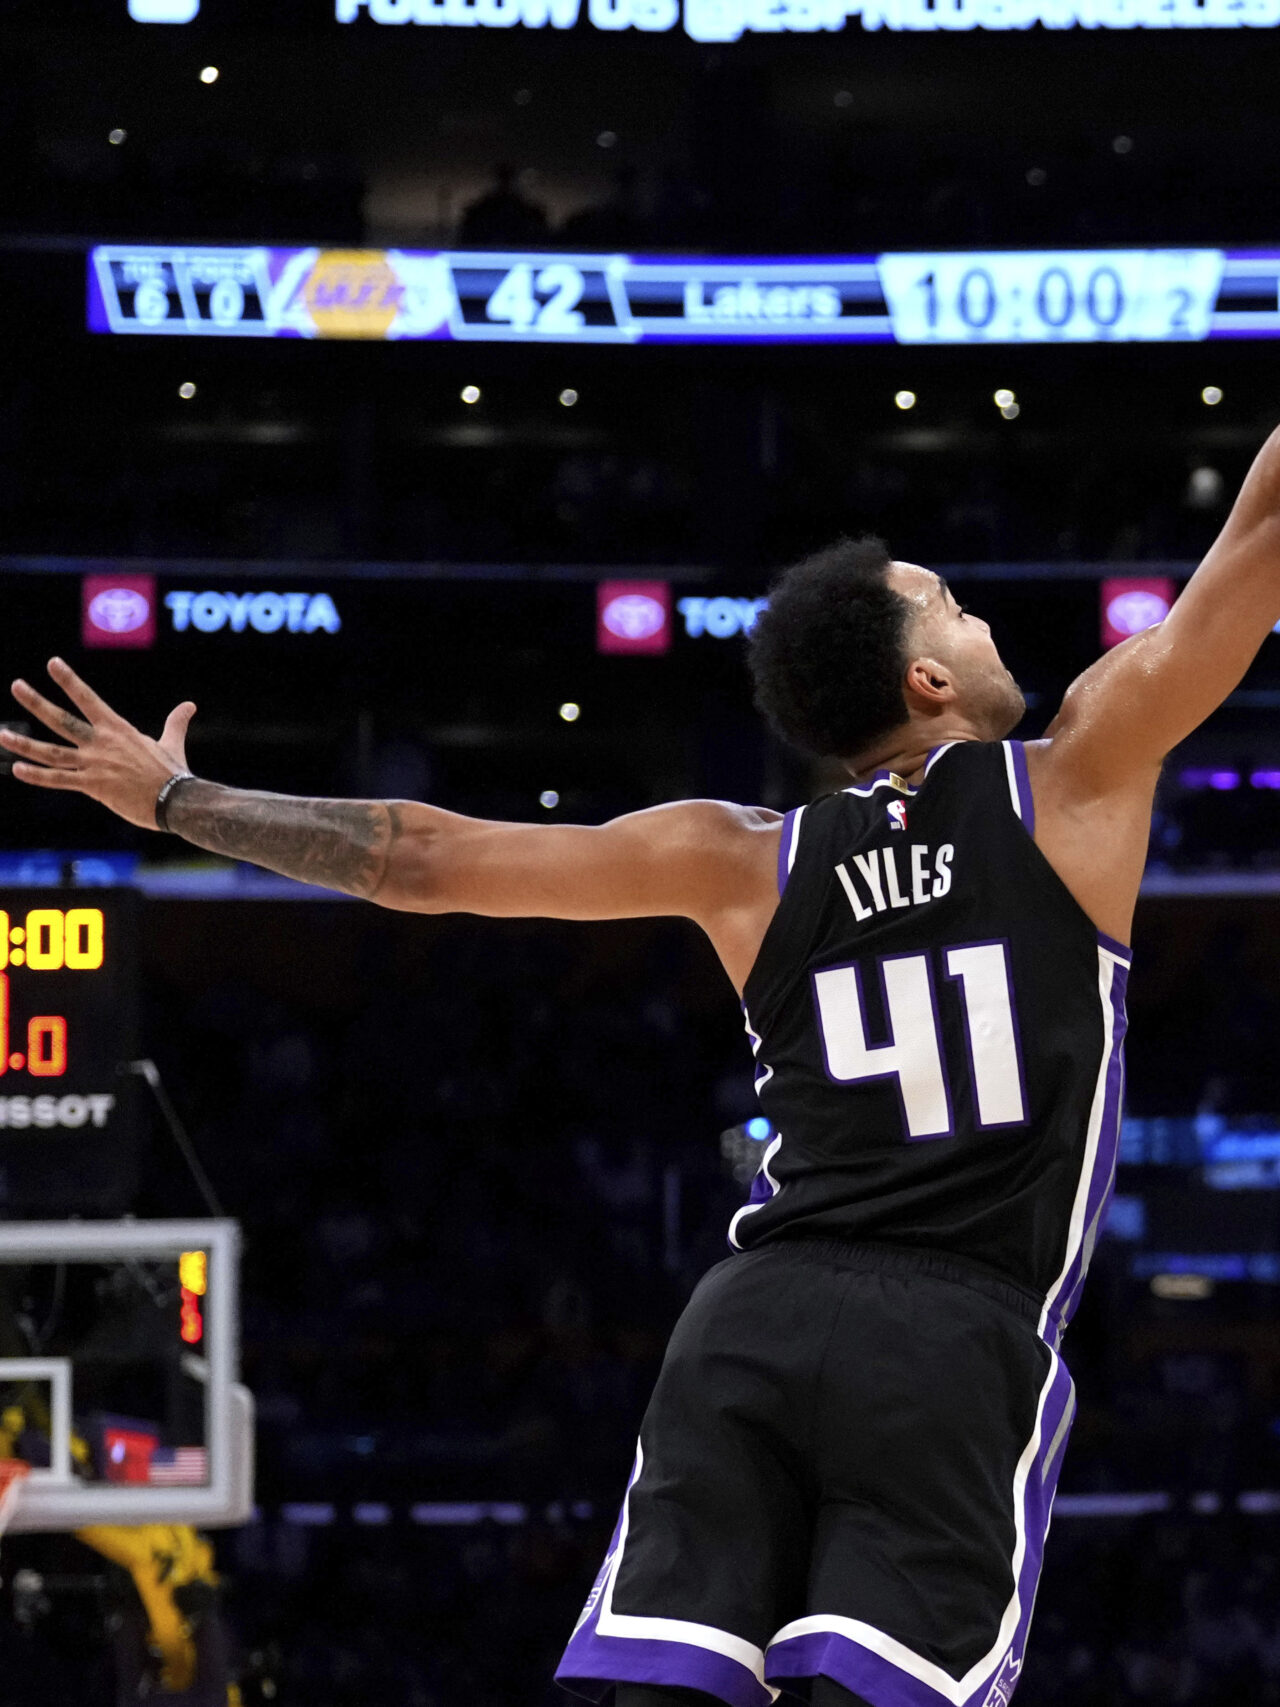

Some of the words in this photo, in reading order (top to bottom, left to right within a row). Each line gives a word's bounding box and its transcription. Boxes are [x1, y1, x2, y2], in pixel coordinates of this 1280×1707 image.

[209, 278, 245, 327] 0
[486, 262, 585, 333] 42
[684, 277, 843, 324] Lakers
[914, 266, 1126, 328] 10:00
[1169, 286, 1195, 328] 2
[165, 591, 342, 633] TOYOTA
[834, 843, 955, 922] LYLES
[0, 908, 104, 971] :00
[811, 937, 1030, 1143] 41
